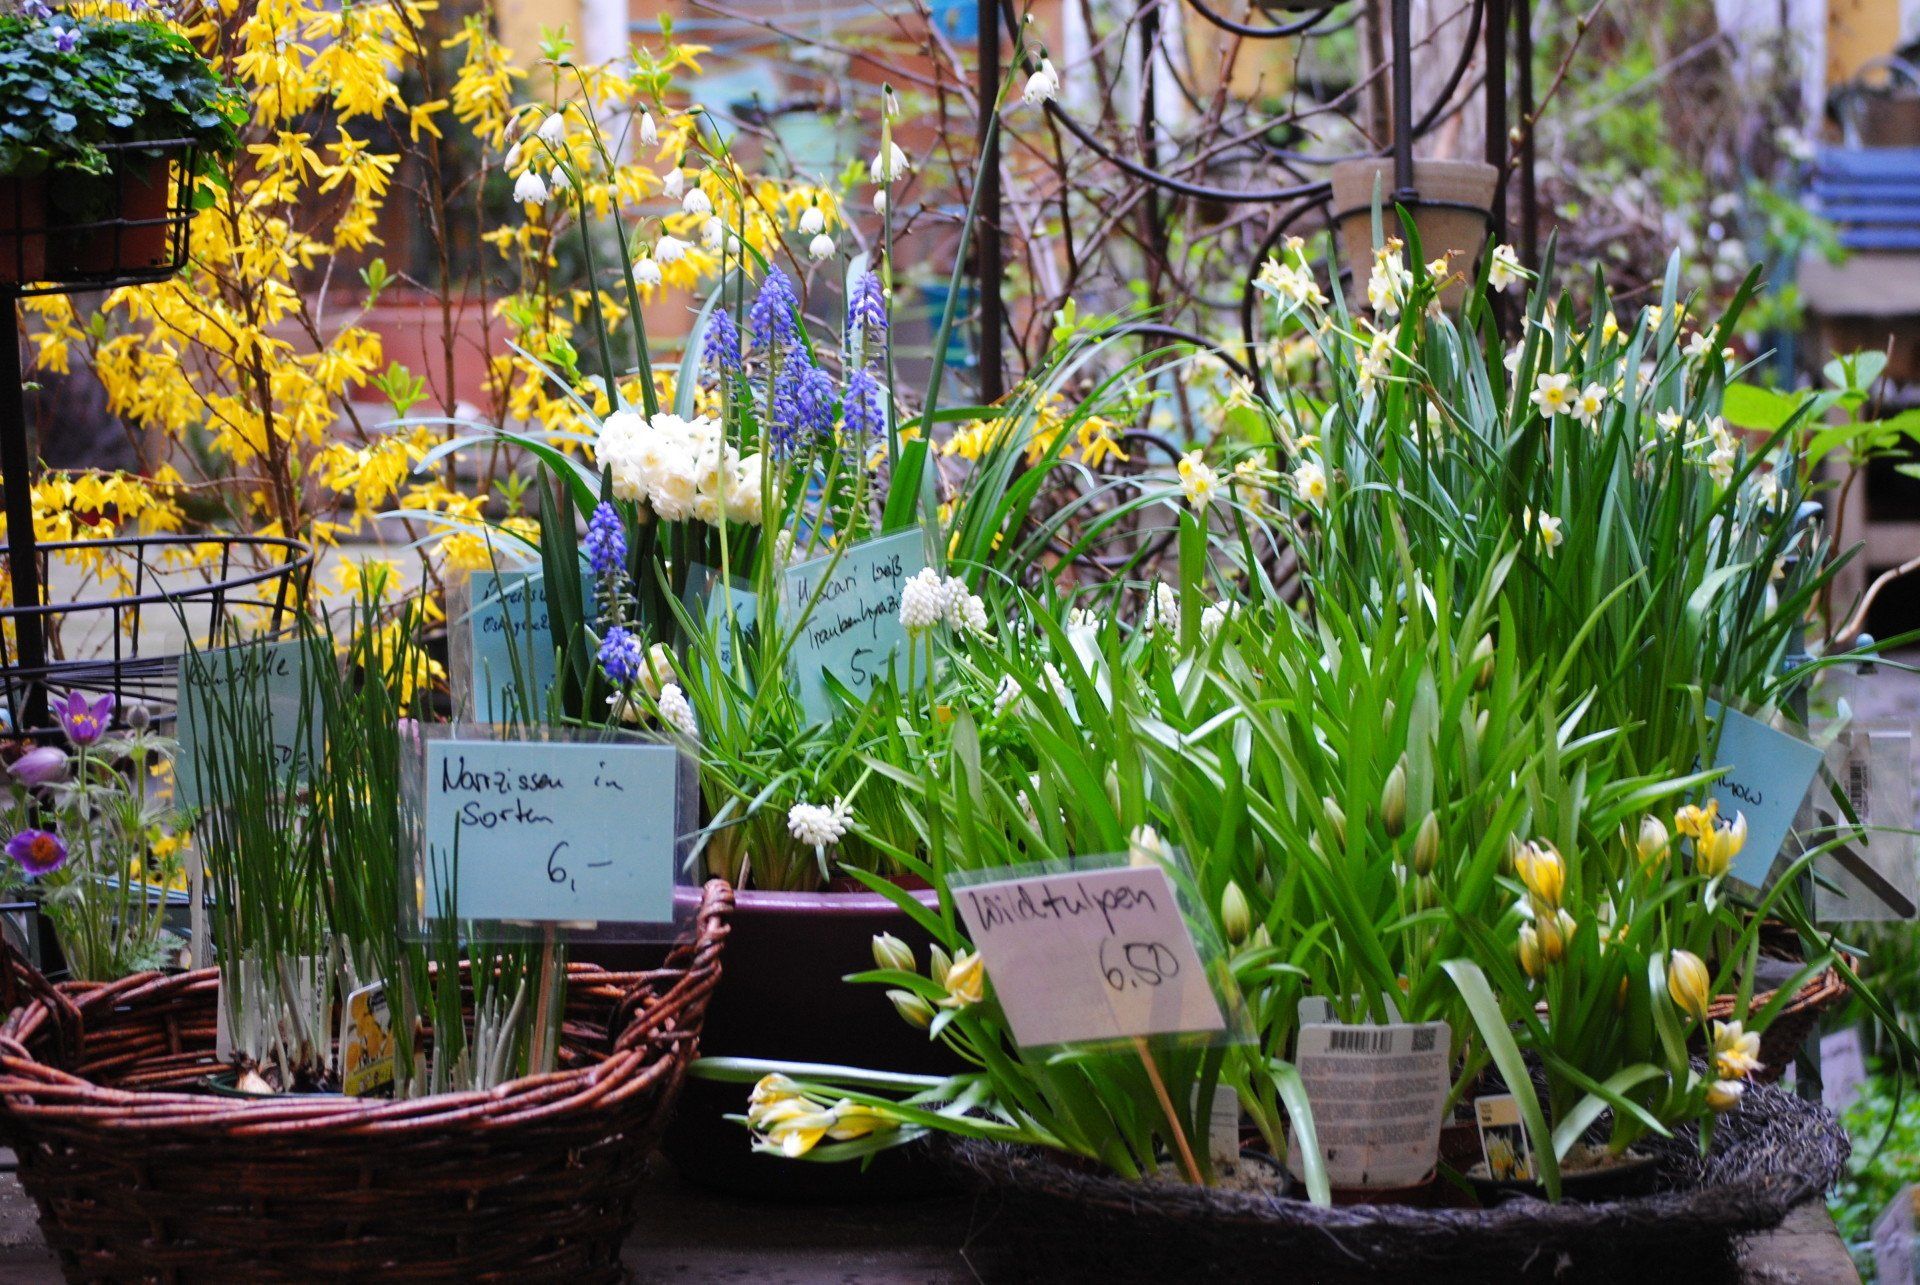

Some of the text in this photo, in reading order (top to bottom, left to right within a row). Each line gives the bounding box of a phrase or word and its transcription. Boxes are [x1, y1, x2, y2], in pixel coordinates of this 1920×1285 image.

[798, 565, 857, 608] Mscari
[800, 592, 902, 651] Traubenhyazi
[442, 756, 624, 794] Narzissen in
[460, 798, 554, 829] Sorten
[968, 881, 1158, 936] Wildtulpen
